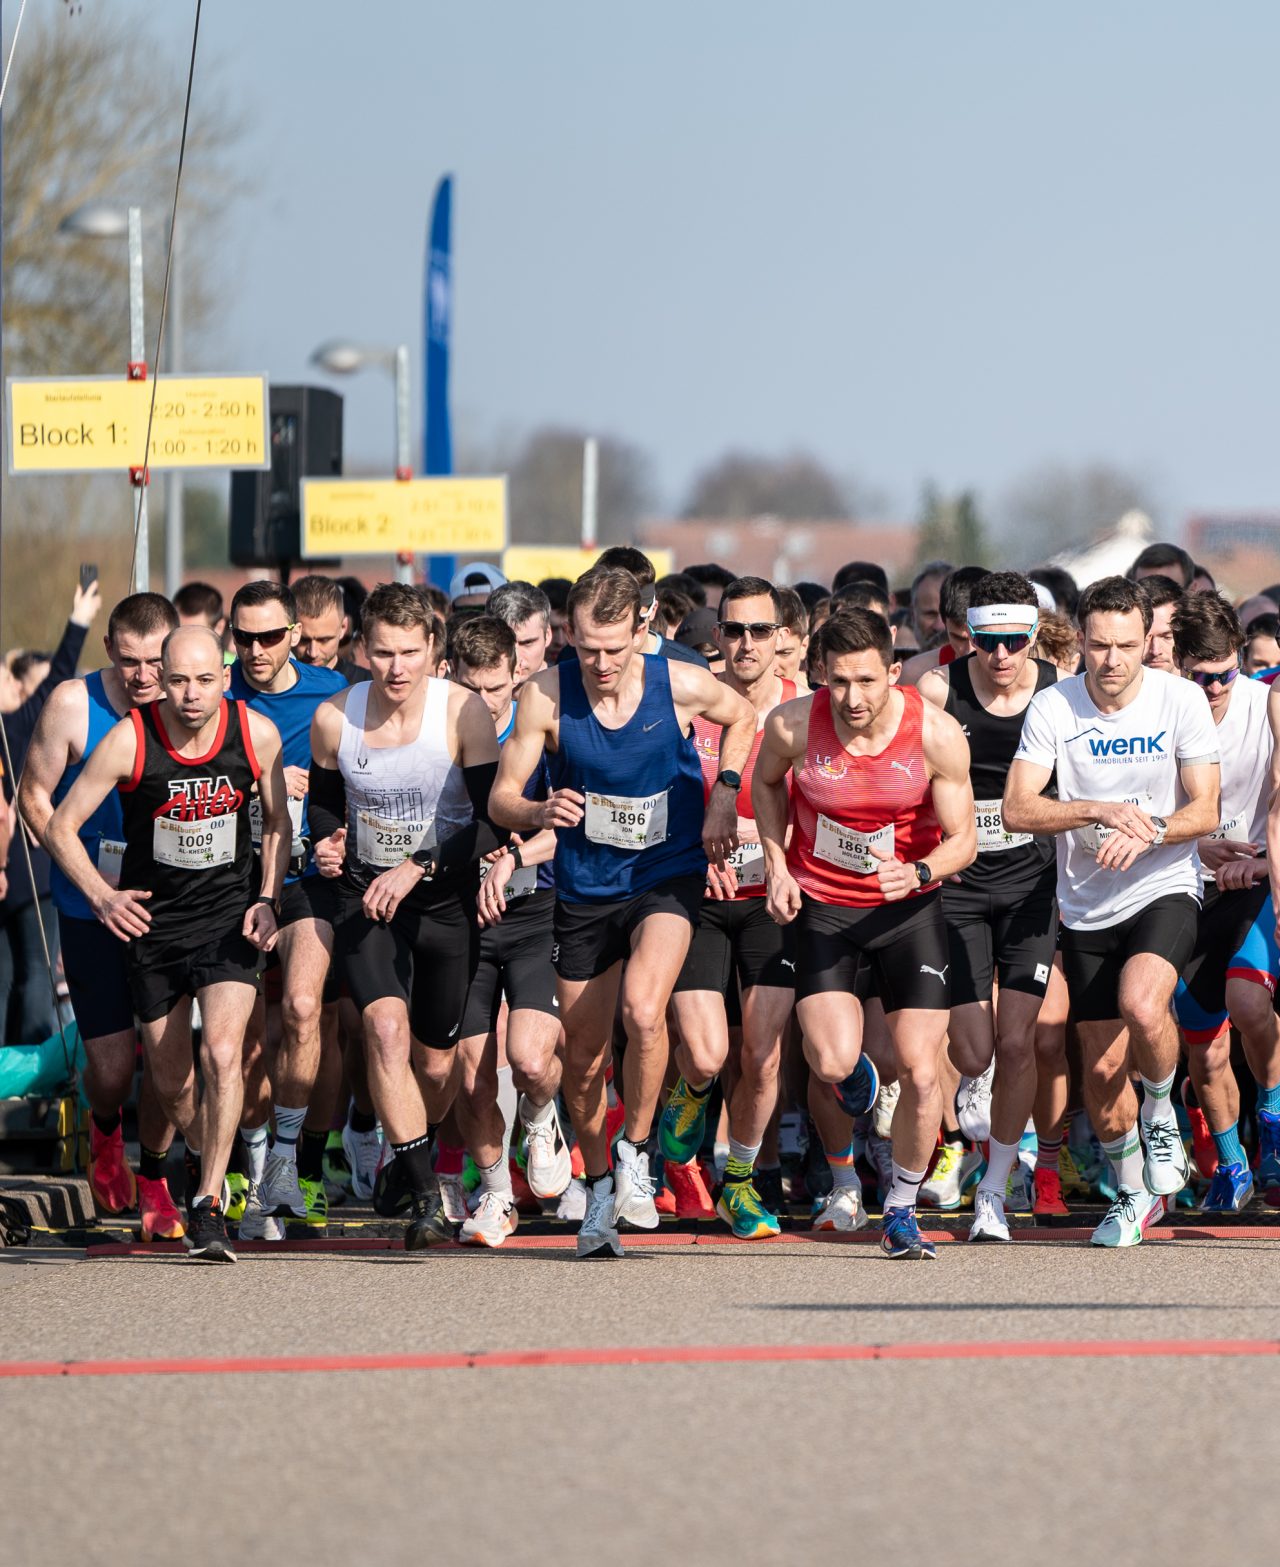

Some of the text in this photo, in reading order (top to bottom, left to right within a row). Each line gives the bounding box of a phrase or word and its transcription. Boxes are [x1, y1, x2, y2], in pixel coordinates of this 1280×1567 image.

[203, 401, 241, 417] 2:50
[246, 400, 256, 417] h
[20, 421, 128, 447] Block 1:
[151, 439, 186, 455] 1:00
[206, 438, 241, 454] 1:20
[247, 437, 257, 454] h
[310, 515, 369, 536] Block
[1089, 731, 1166, 756] wenk
[1093, 757, 1133, 765] IMMOBILIEN
[1152, 753, 1168, 761] 1958
[610, 811, 645, 825] 1896
[976, 814, 1001, 828] 188
[178, 833, 213, 847] 1009
[376, 832, 412, 846] 2328
[841, 850, 865, 860] HOLGER
